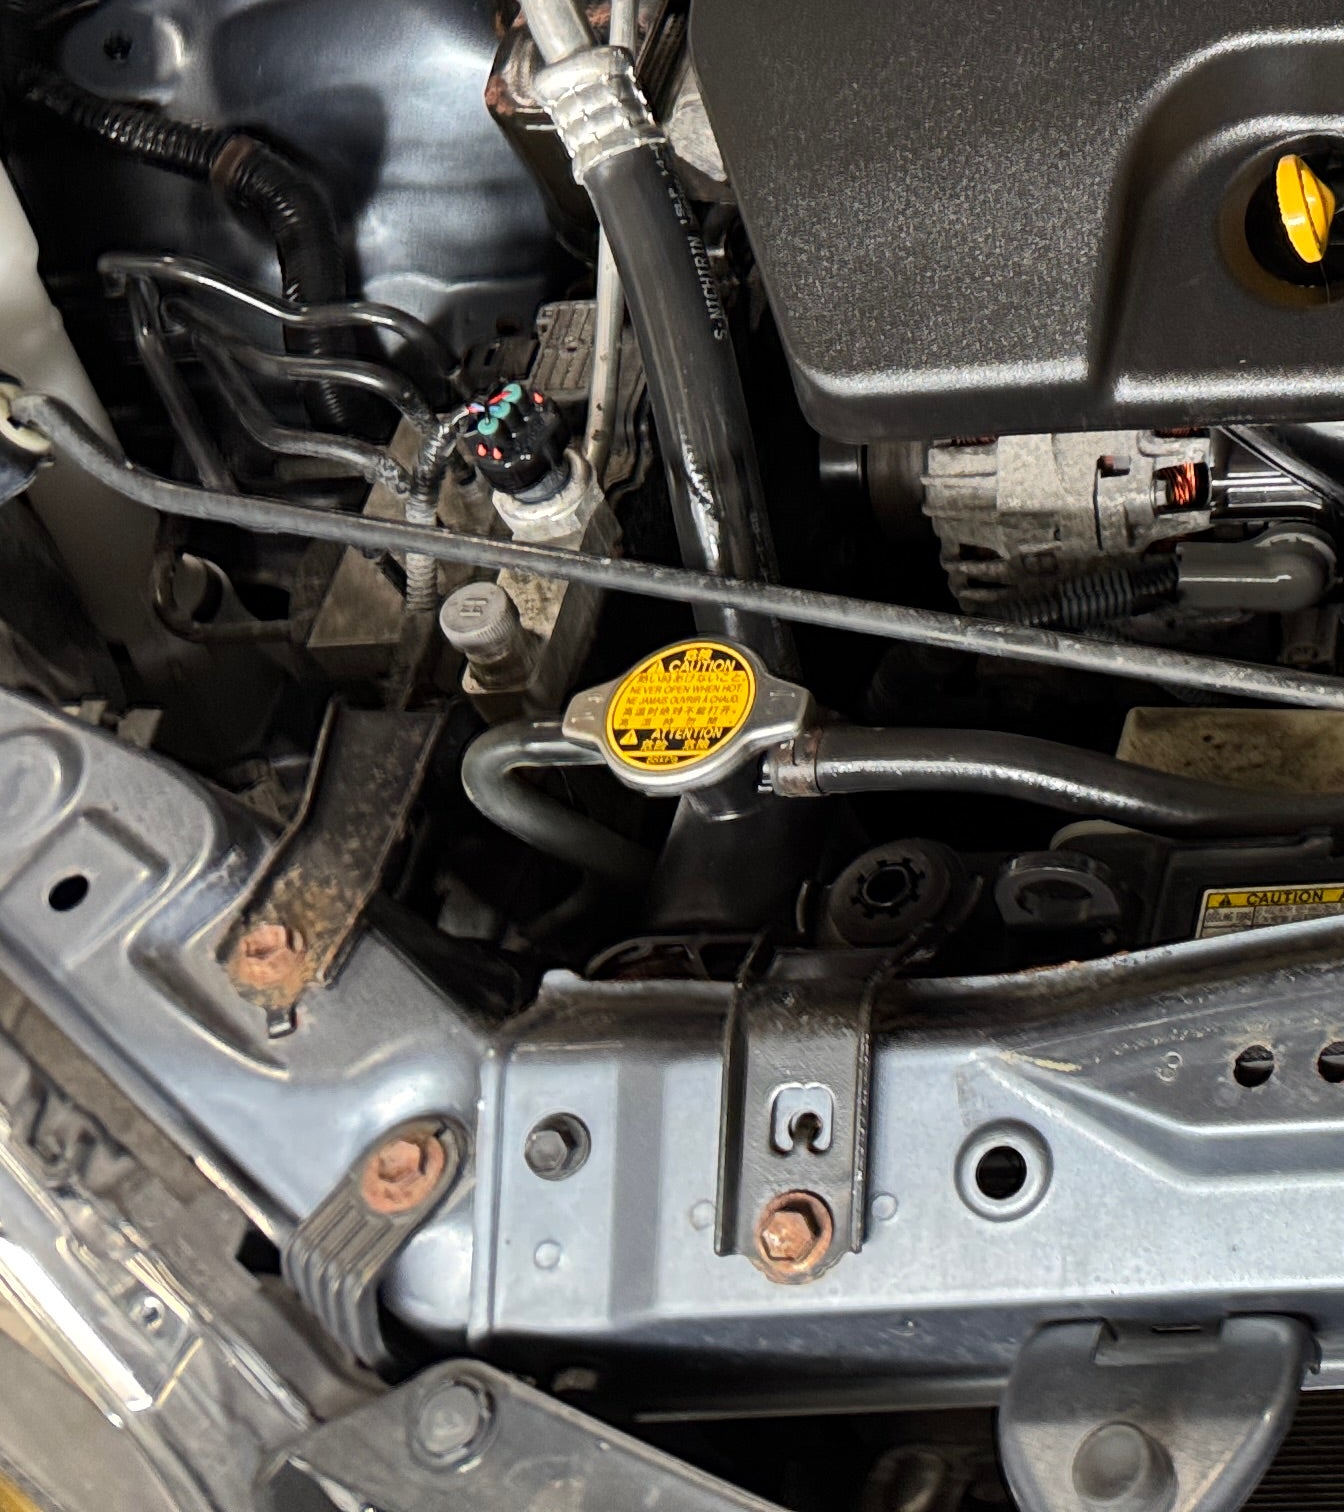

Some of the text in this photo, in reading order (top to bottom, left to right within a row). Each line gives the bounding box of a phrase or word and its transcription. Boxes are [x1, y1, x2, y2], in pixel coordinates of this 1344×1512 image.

[668, 659, 736, 673] CAUTION
[630, 685, 662, 694] NEVER
[664, 685, 690, 694] OPEN
[692, 685, 719, 693] WHEN
[640, 696, 668, 704] JAMAIS
[651, 726, 724, 740] ATTENTION
[1246, 891, 1324, 906] CAUTION
